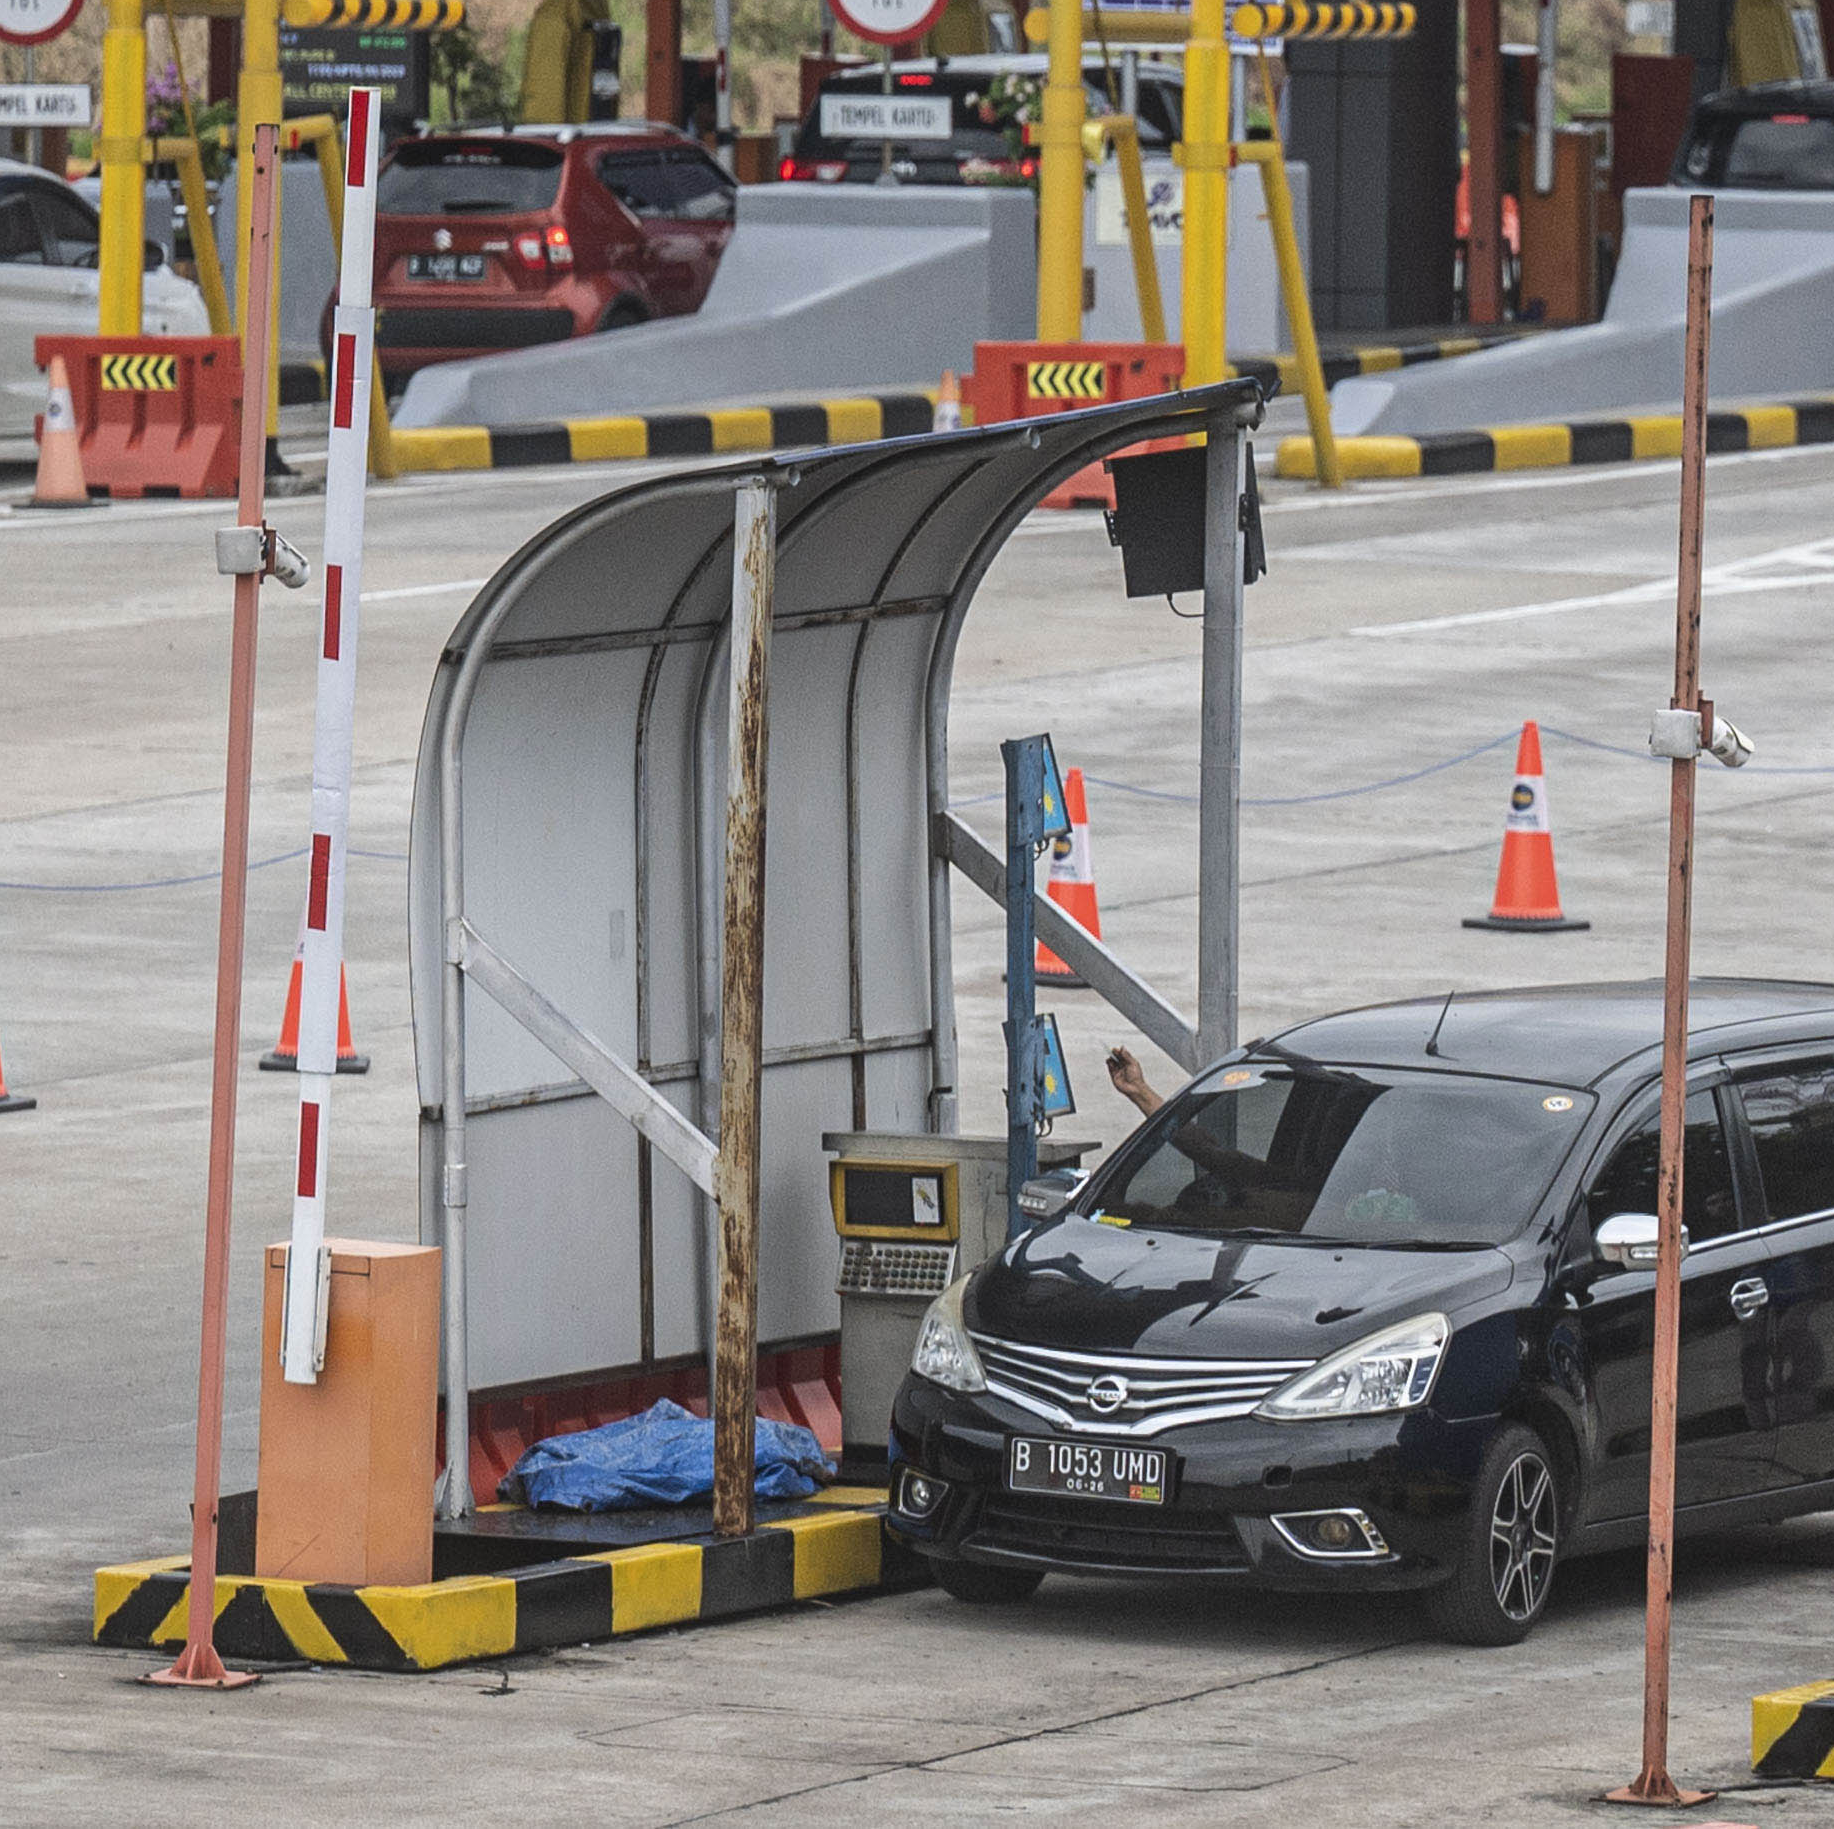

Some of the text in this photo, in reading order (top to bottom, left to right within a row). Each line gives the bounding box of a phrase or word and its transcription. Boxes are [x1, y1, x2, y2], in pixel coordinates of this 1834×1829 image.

[35, 94, 77, 114] KARTU
[840, 105, 885, 127] TEMPEL
[1015, 1441, 1161, 1484] B 1053 UMD
